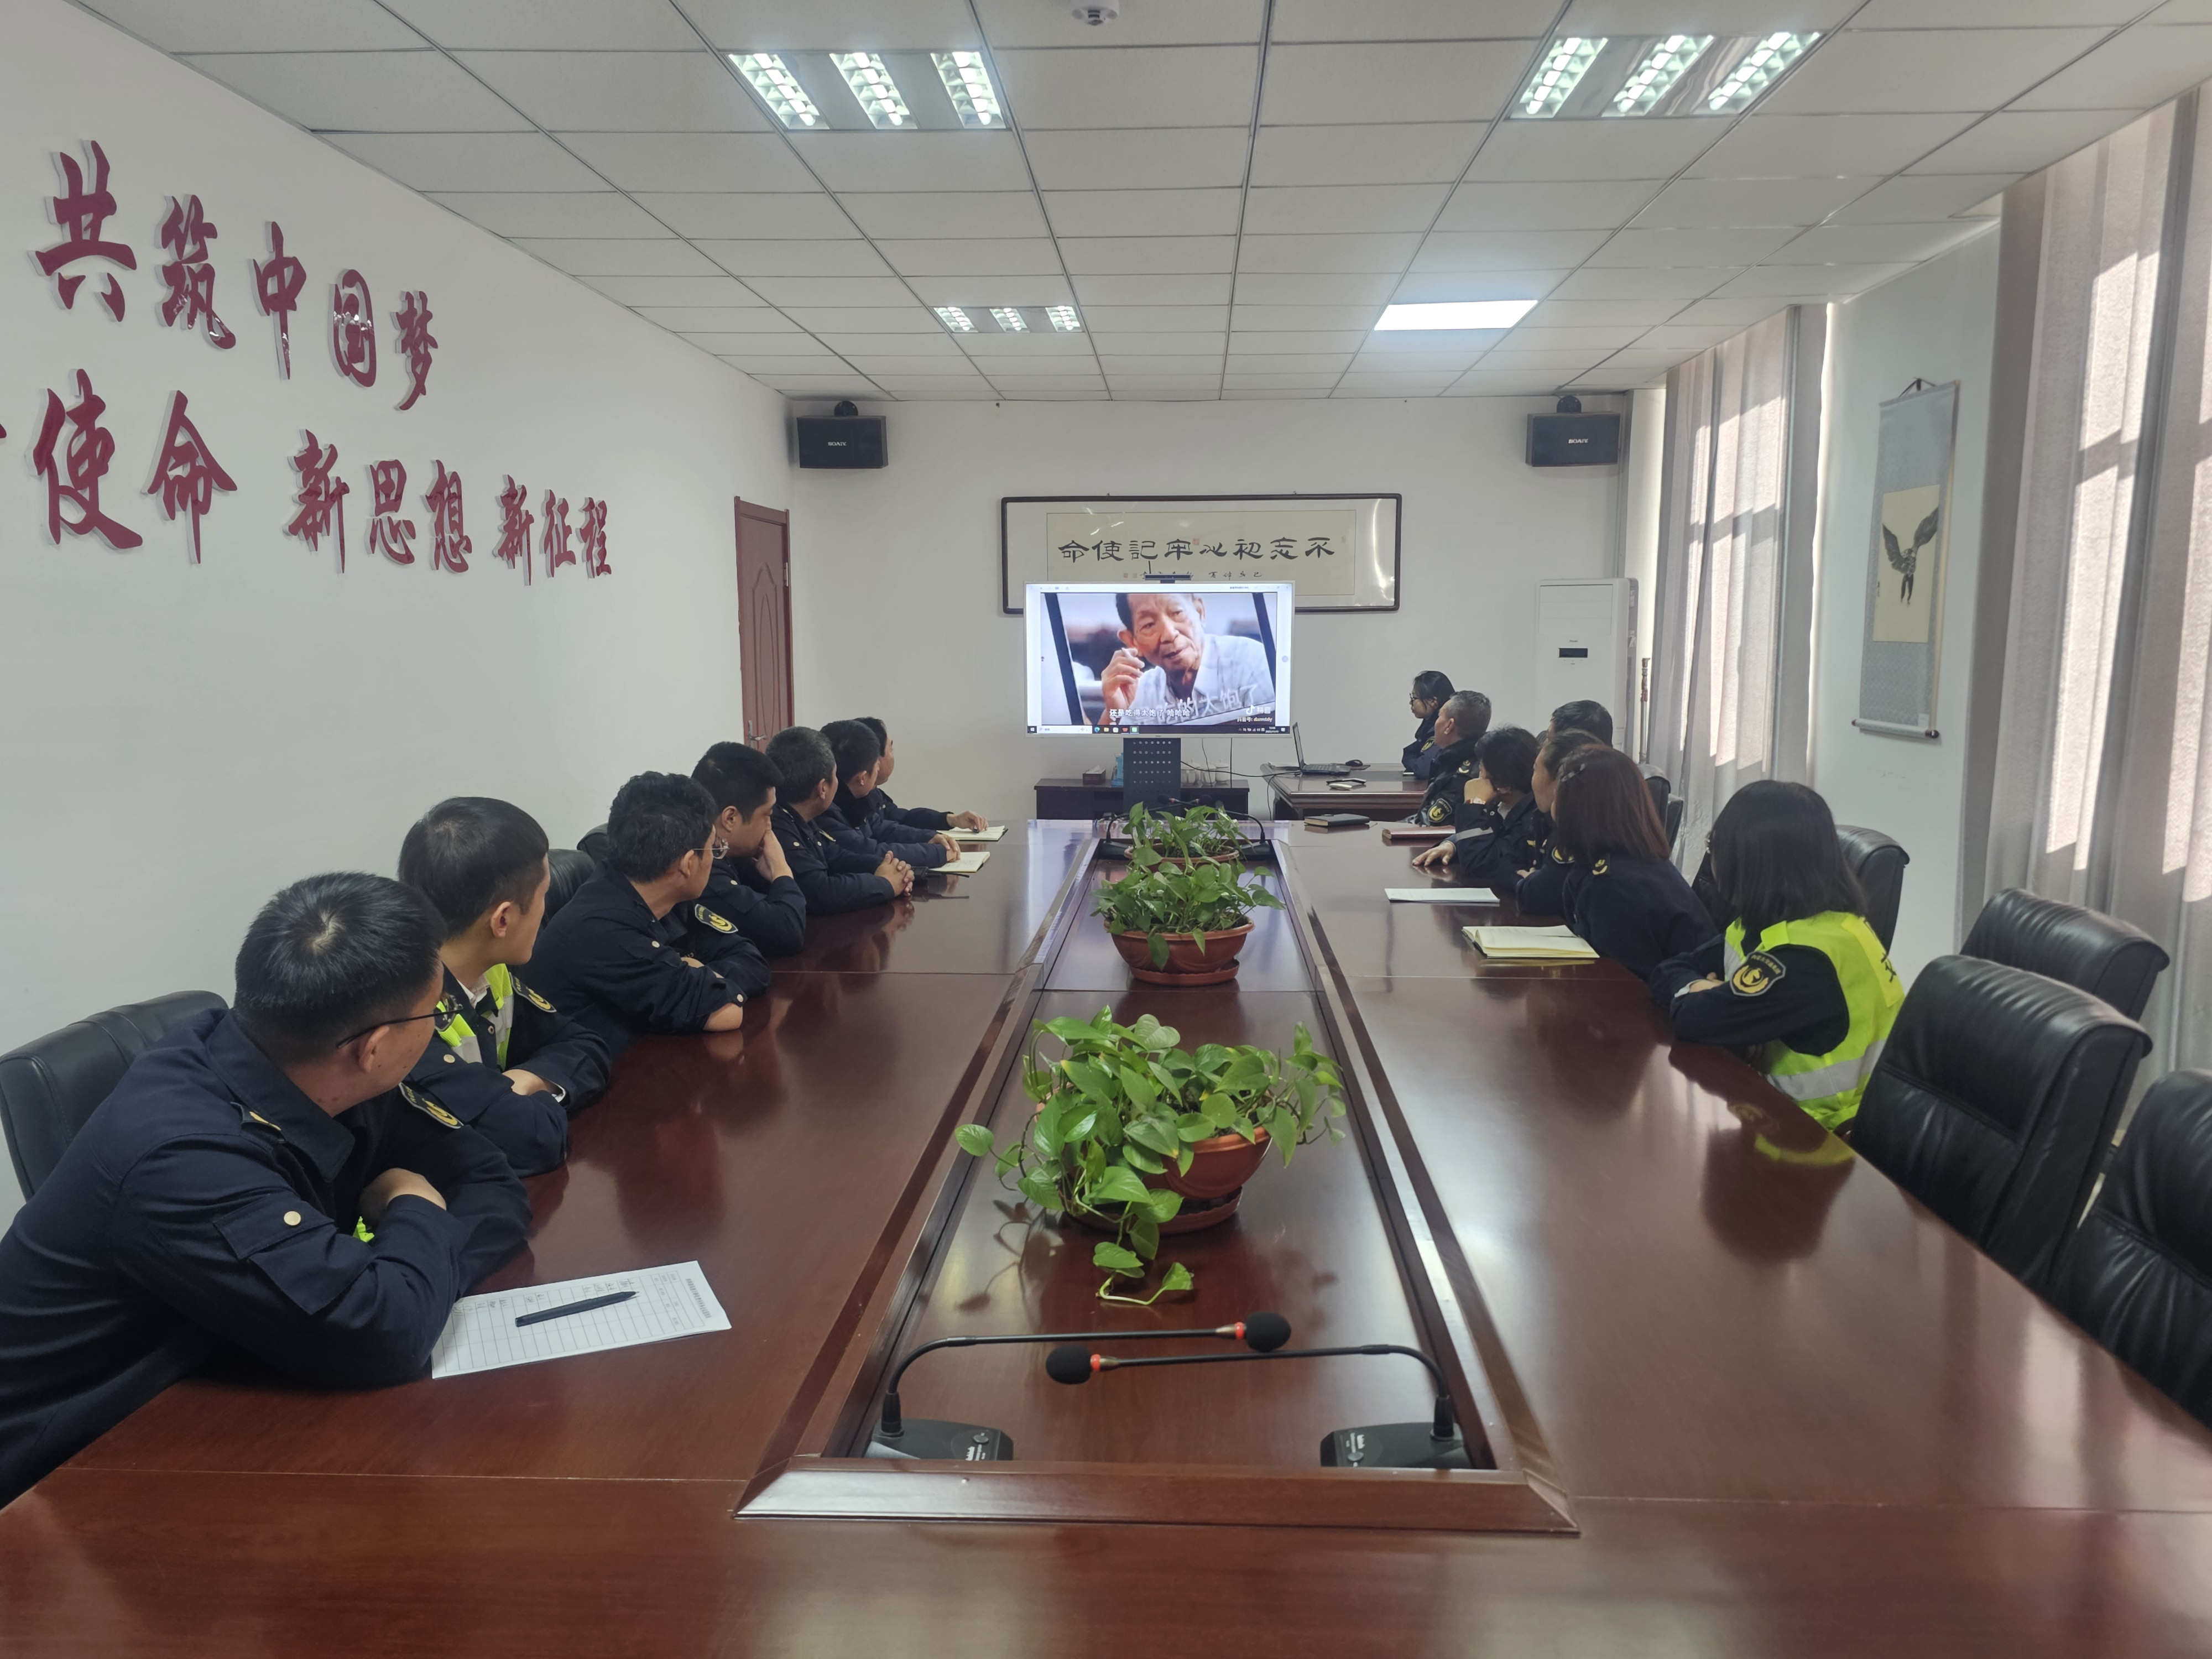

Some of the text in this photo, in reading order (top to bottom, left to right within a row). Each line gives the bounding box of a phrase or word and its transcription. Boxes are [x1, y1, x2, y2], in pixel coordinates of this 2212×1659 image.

[29, 139, 437, 410] 共筑中国梦
[0, 368, 612, 586] 使命 新思想 新征程
